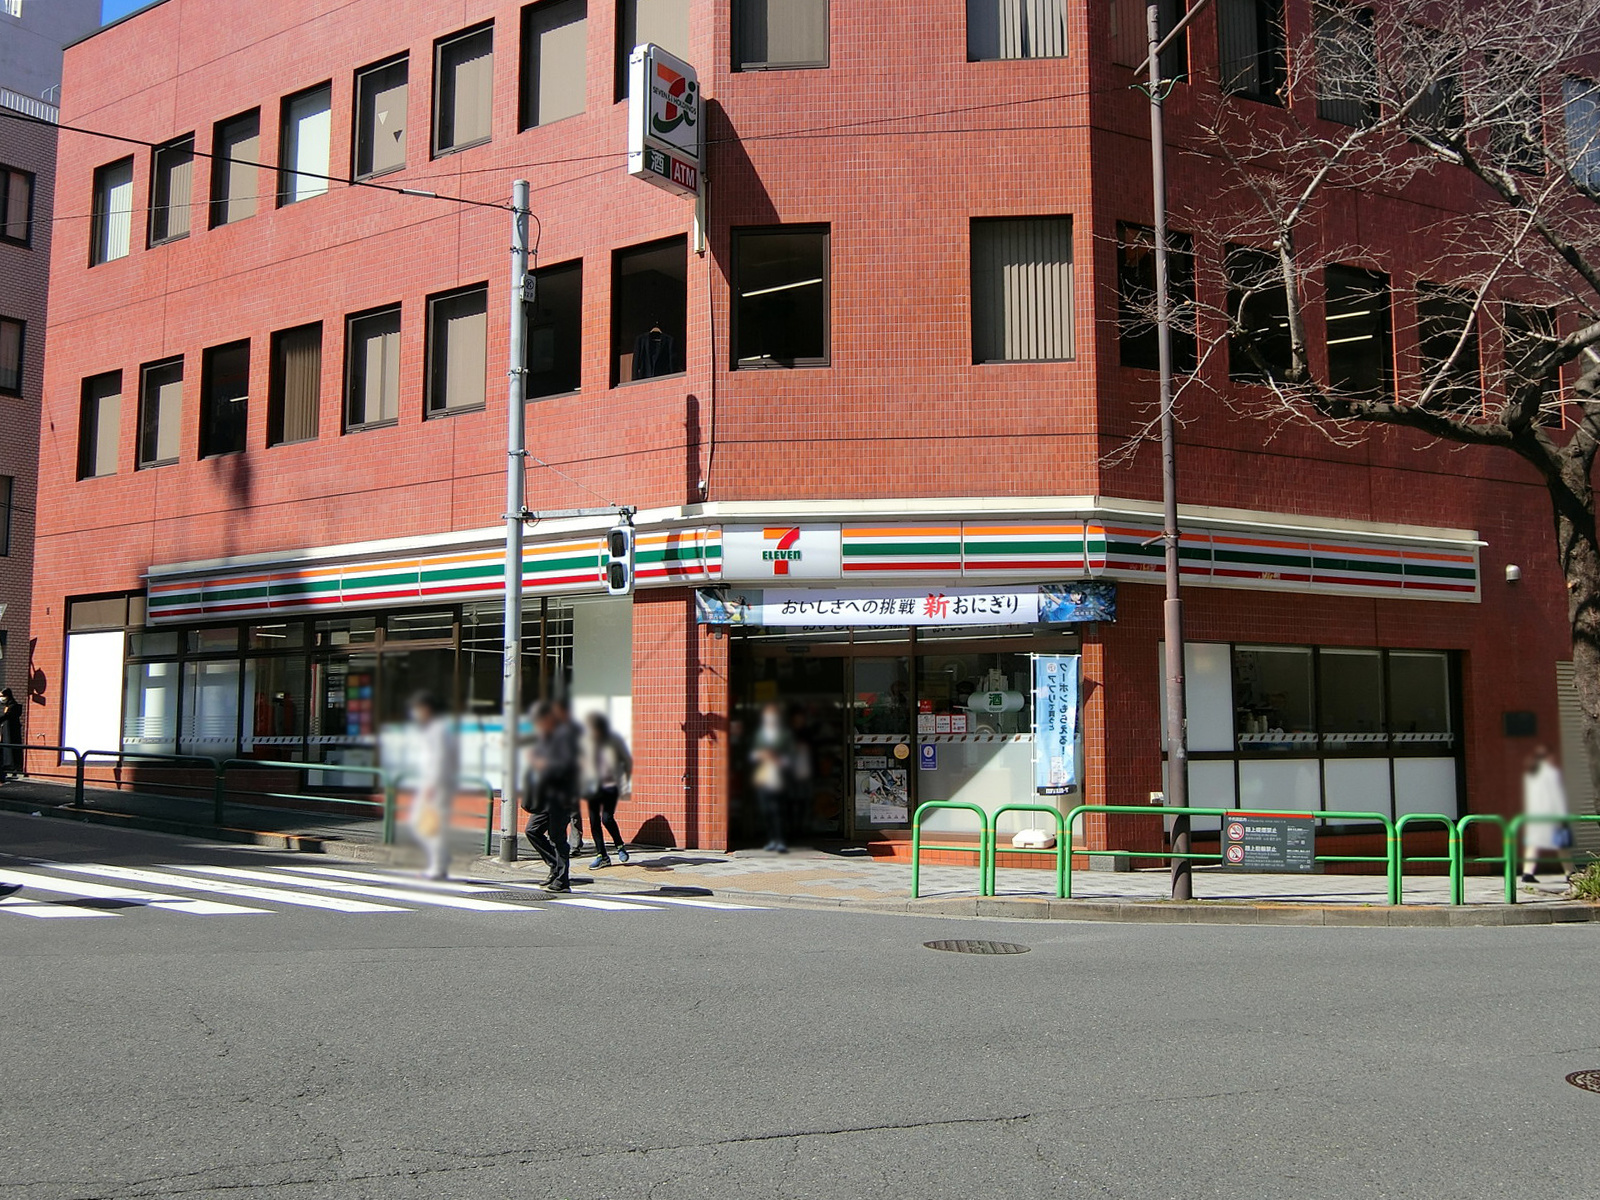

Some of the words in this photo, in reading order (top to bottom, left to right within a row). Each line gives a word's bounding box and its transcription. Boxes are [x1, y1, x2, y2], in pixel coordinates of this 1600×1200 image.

[673, 97, 697, 115] HOLDINGS
[651, 150, 665, 175] 酒
[674, 162, 695, 189] ATM
[763, 526, 800, 575] 7
[989, 693, 1003, 706] 酒
